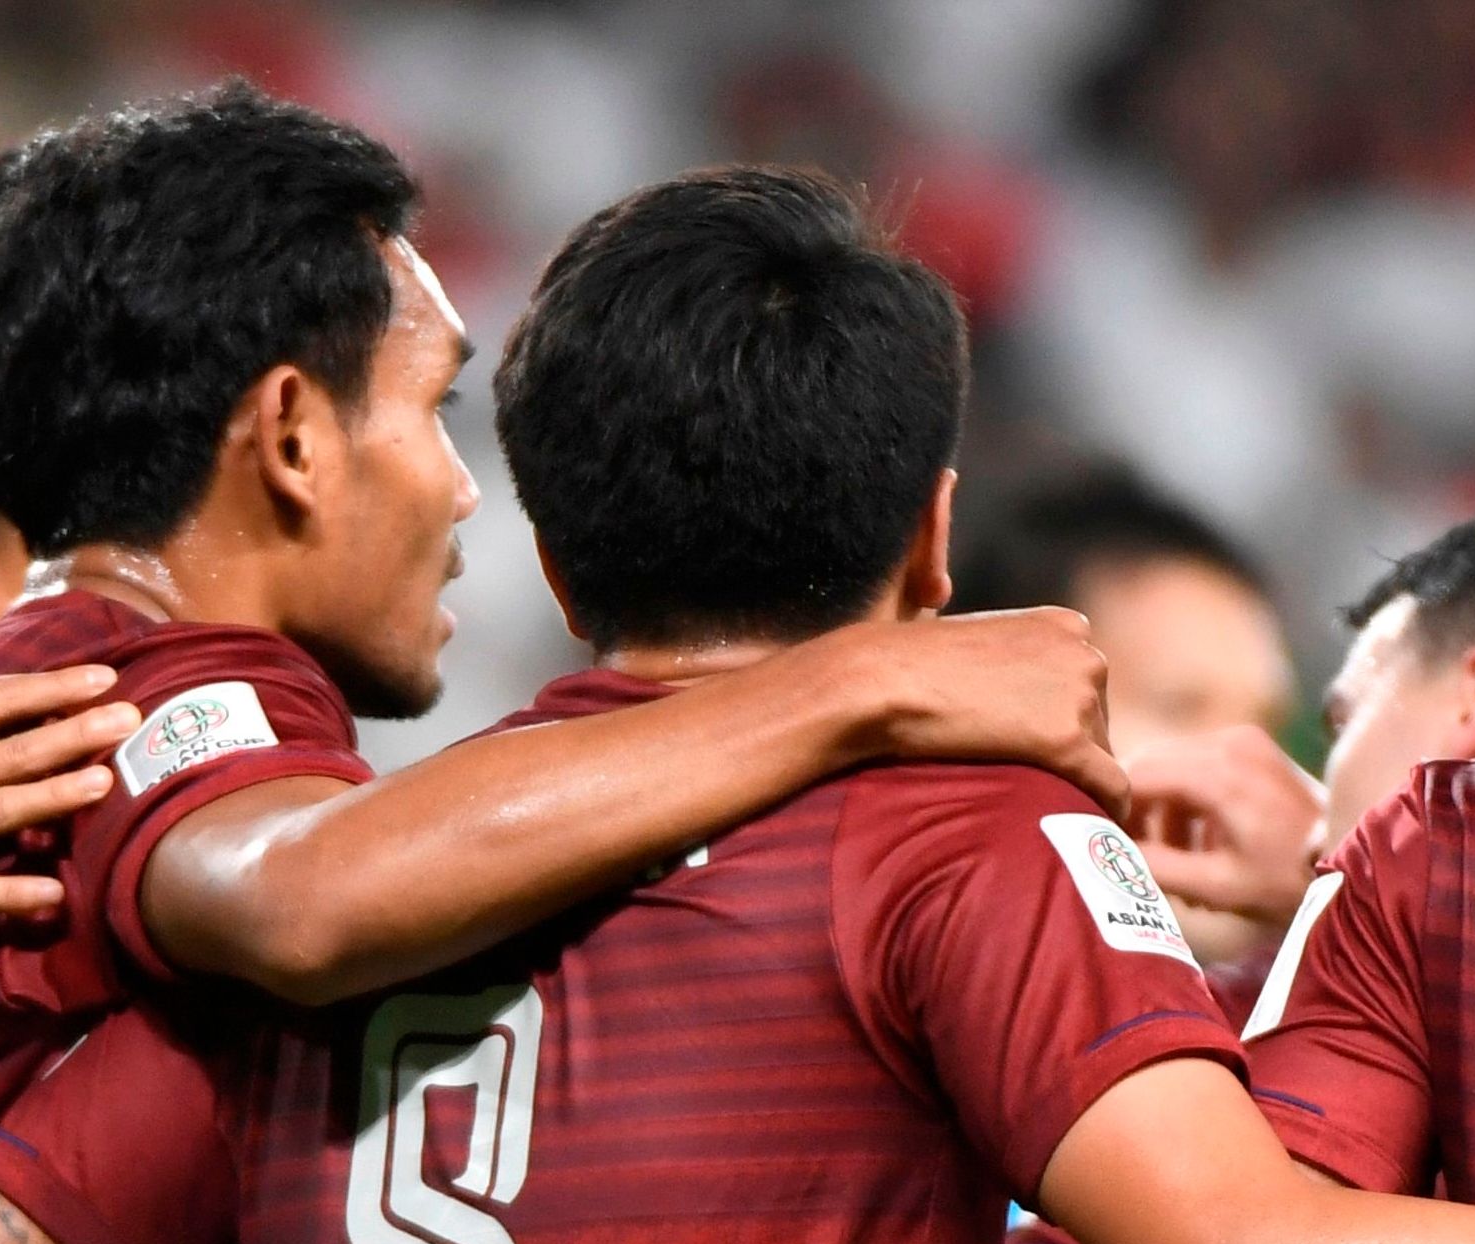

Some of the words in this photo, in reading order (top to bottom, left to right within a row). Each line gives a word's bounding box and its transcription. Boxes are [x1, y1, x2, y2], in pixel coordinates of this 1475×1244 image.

[179, 735, 215, 758] AFC
[1135, 902, 1164, 919] AFC
[1107, 911, 1165, 931] ASIAN
